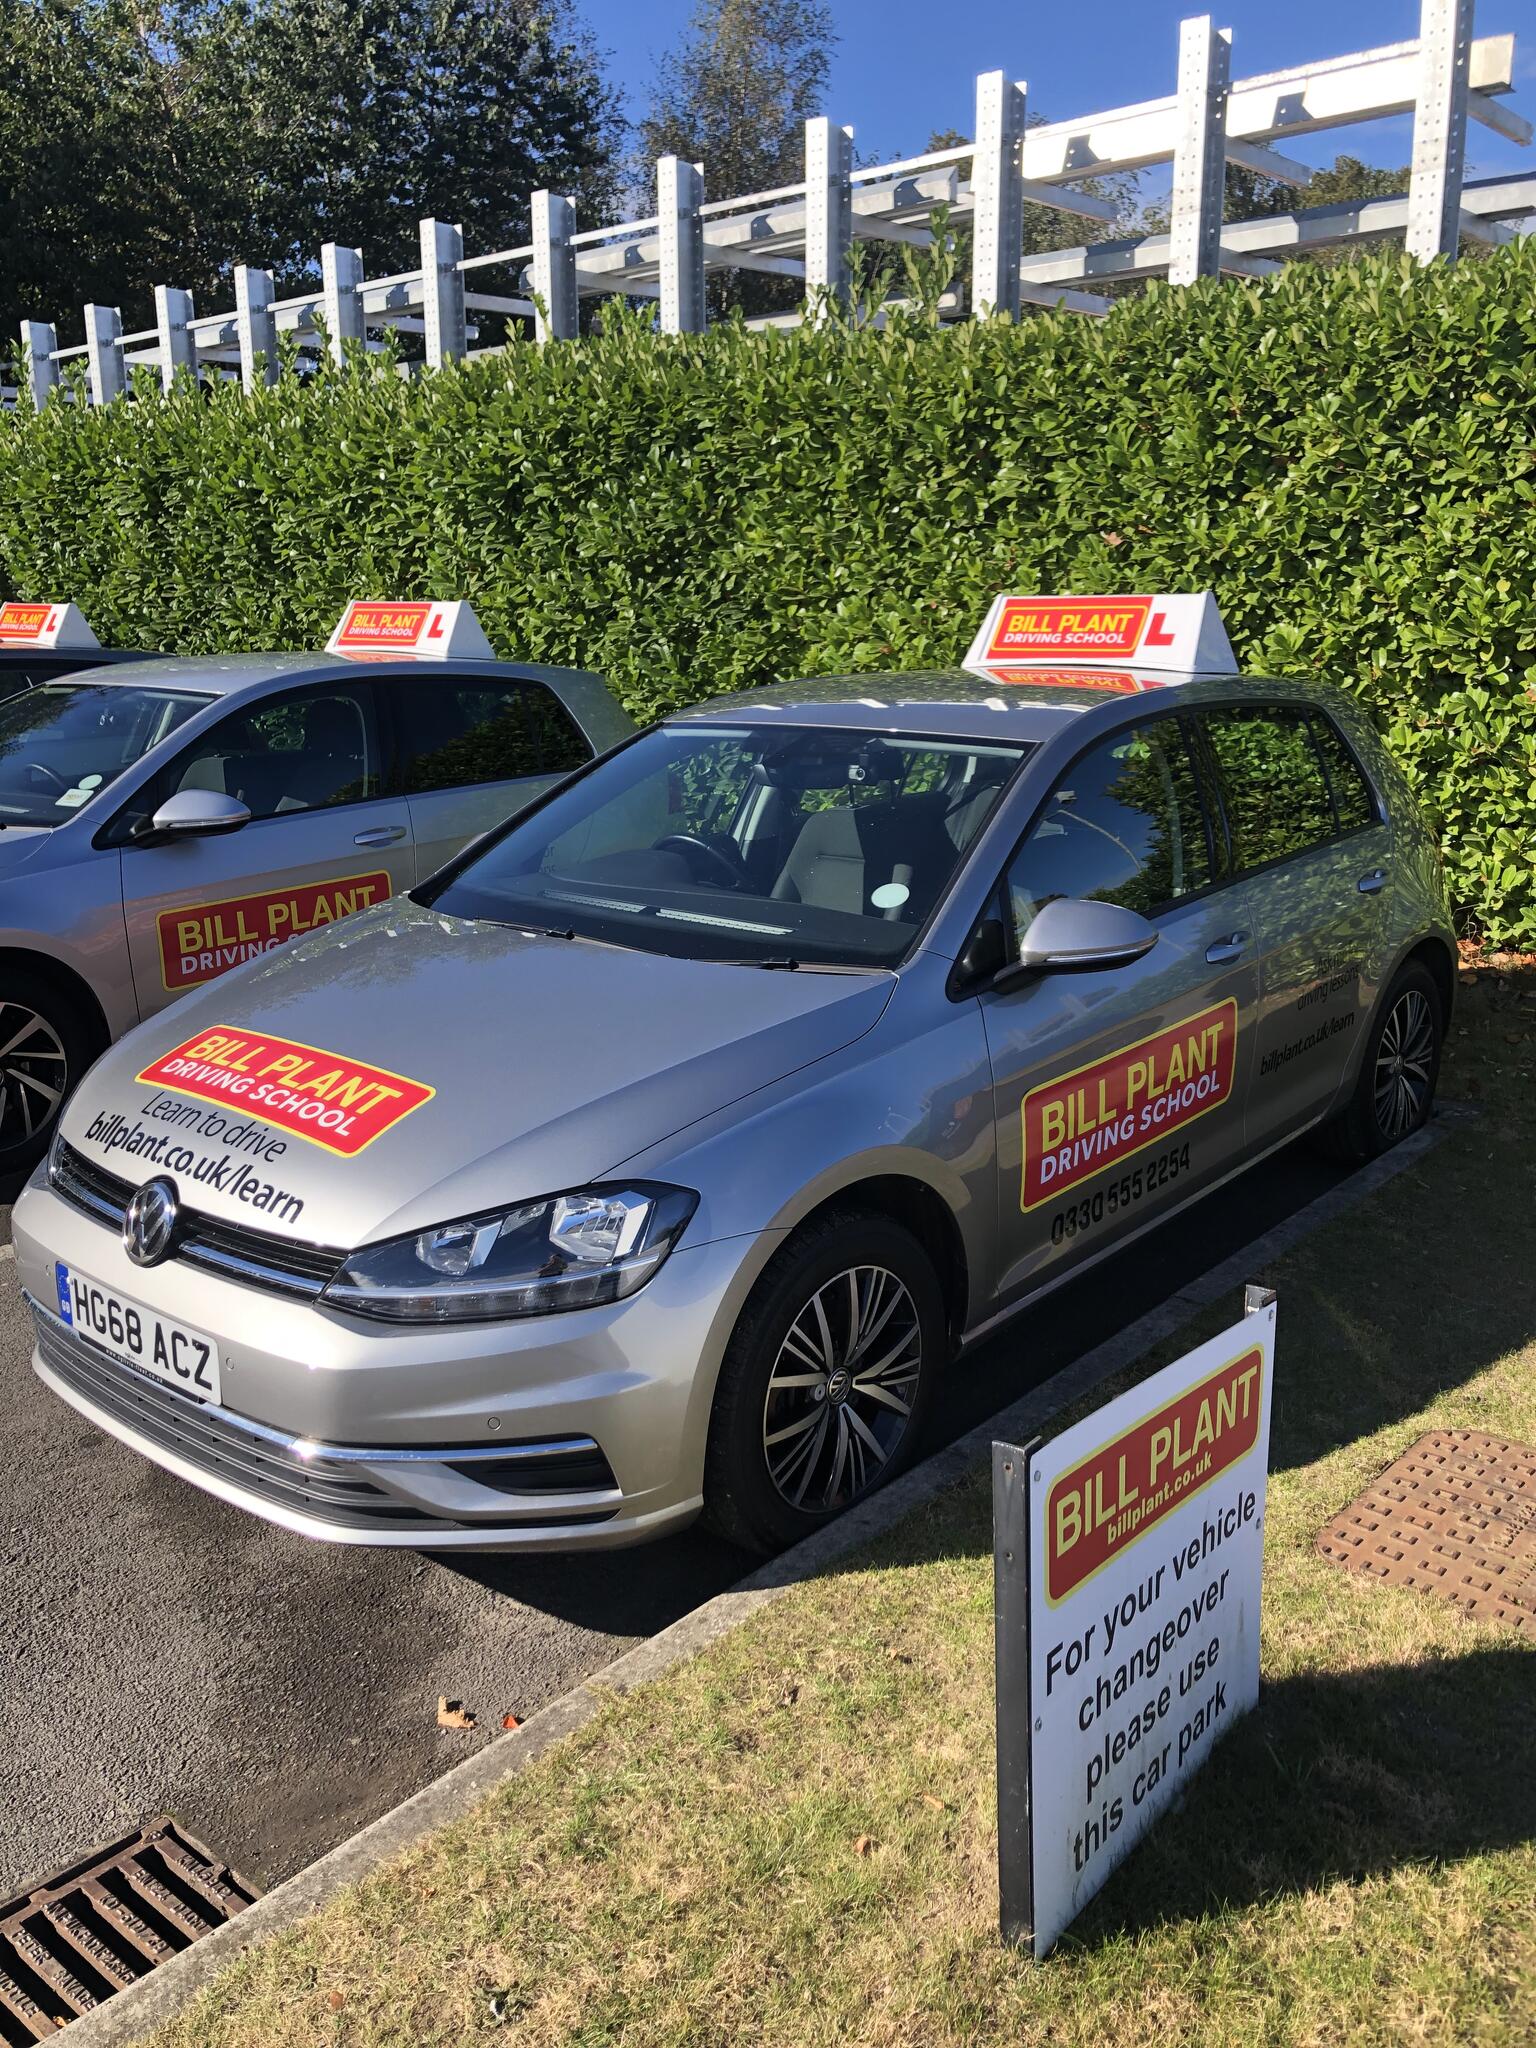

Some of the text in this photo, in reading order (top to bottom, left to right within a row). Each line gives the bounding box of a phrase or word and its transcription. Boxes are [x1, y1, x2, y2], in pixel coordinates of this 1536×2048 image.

[348, 627, 414, 637] DRIVING SCHOOL
[352, 614, 420, 628] BILL PLANT
[427, 614, 444, 638] L
[1002, 633, 1126, 644] DRIVING SCHOOL
[1007, 613, 1135, 633] BILL PLANT
[1143, 613, 1176, 646] L
[177, 885, 376, 954] BILL PLANT
[160, 1058, 360, 1136] DRIVING SCHOOL
[183, 1035, 404, 1115] BILL PLANT
[1041, 1022, 1224, 1153] BILL PLANT
[84, 1111, 304, 1224] billplant.co.uk/learn
[141, 1092, 287, 1164] Learn to drive
[1040, 1070, 1220, 1185] DRIVING SCHOOL
[1051, 1142, 1191, 1245] 0330 555 2254
[73, 1278, 213, 1391] HG68 ACZ
[1055, 1365, 1258, 1559] BILL PLANT
[1107, 1453, 1214, 1546] billplant.co.uk
[1046, 1491, 1257, 1698] For your vehicle
[1078, 1569, 1231, 1731] changeover
[1086, 1637, 1221, 1805] please use
[1072, 1680, 1227, 1873] this car park
